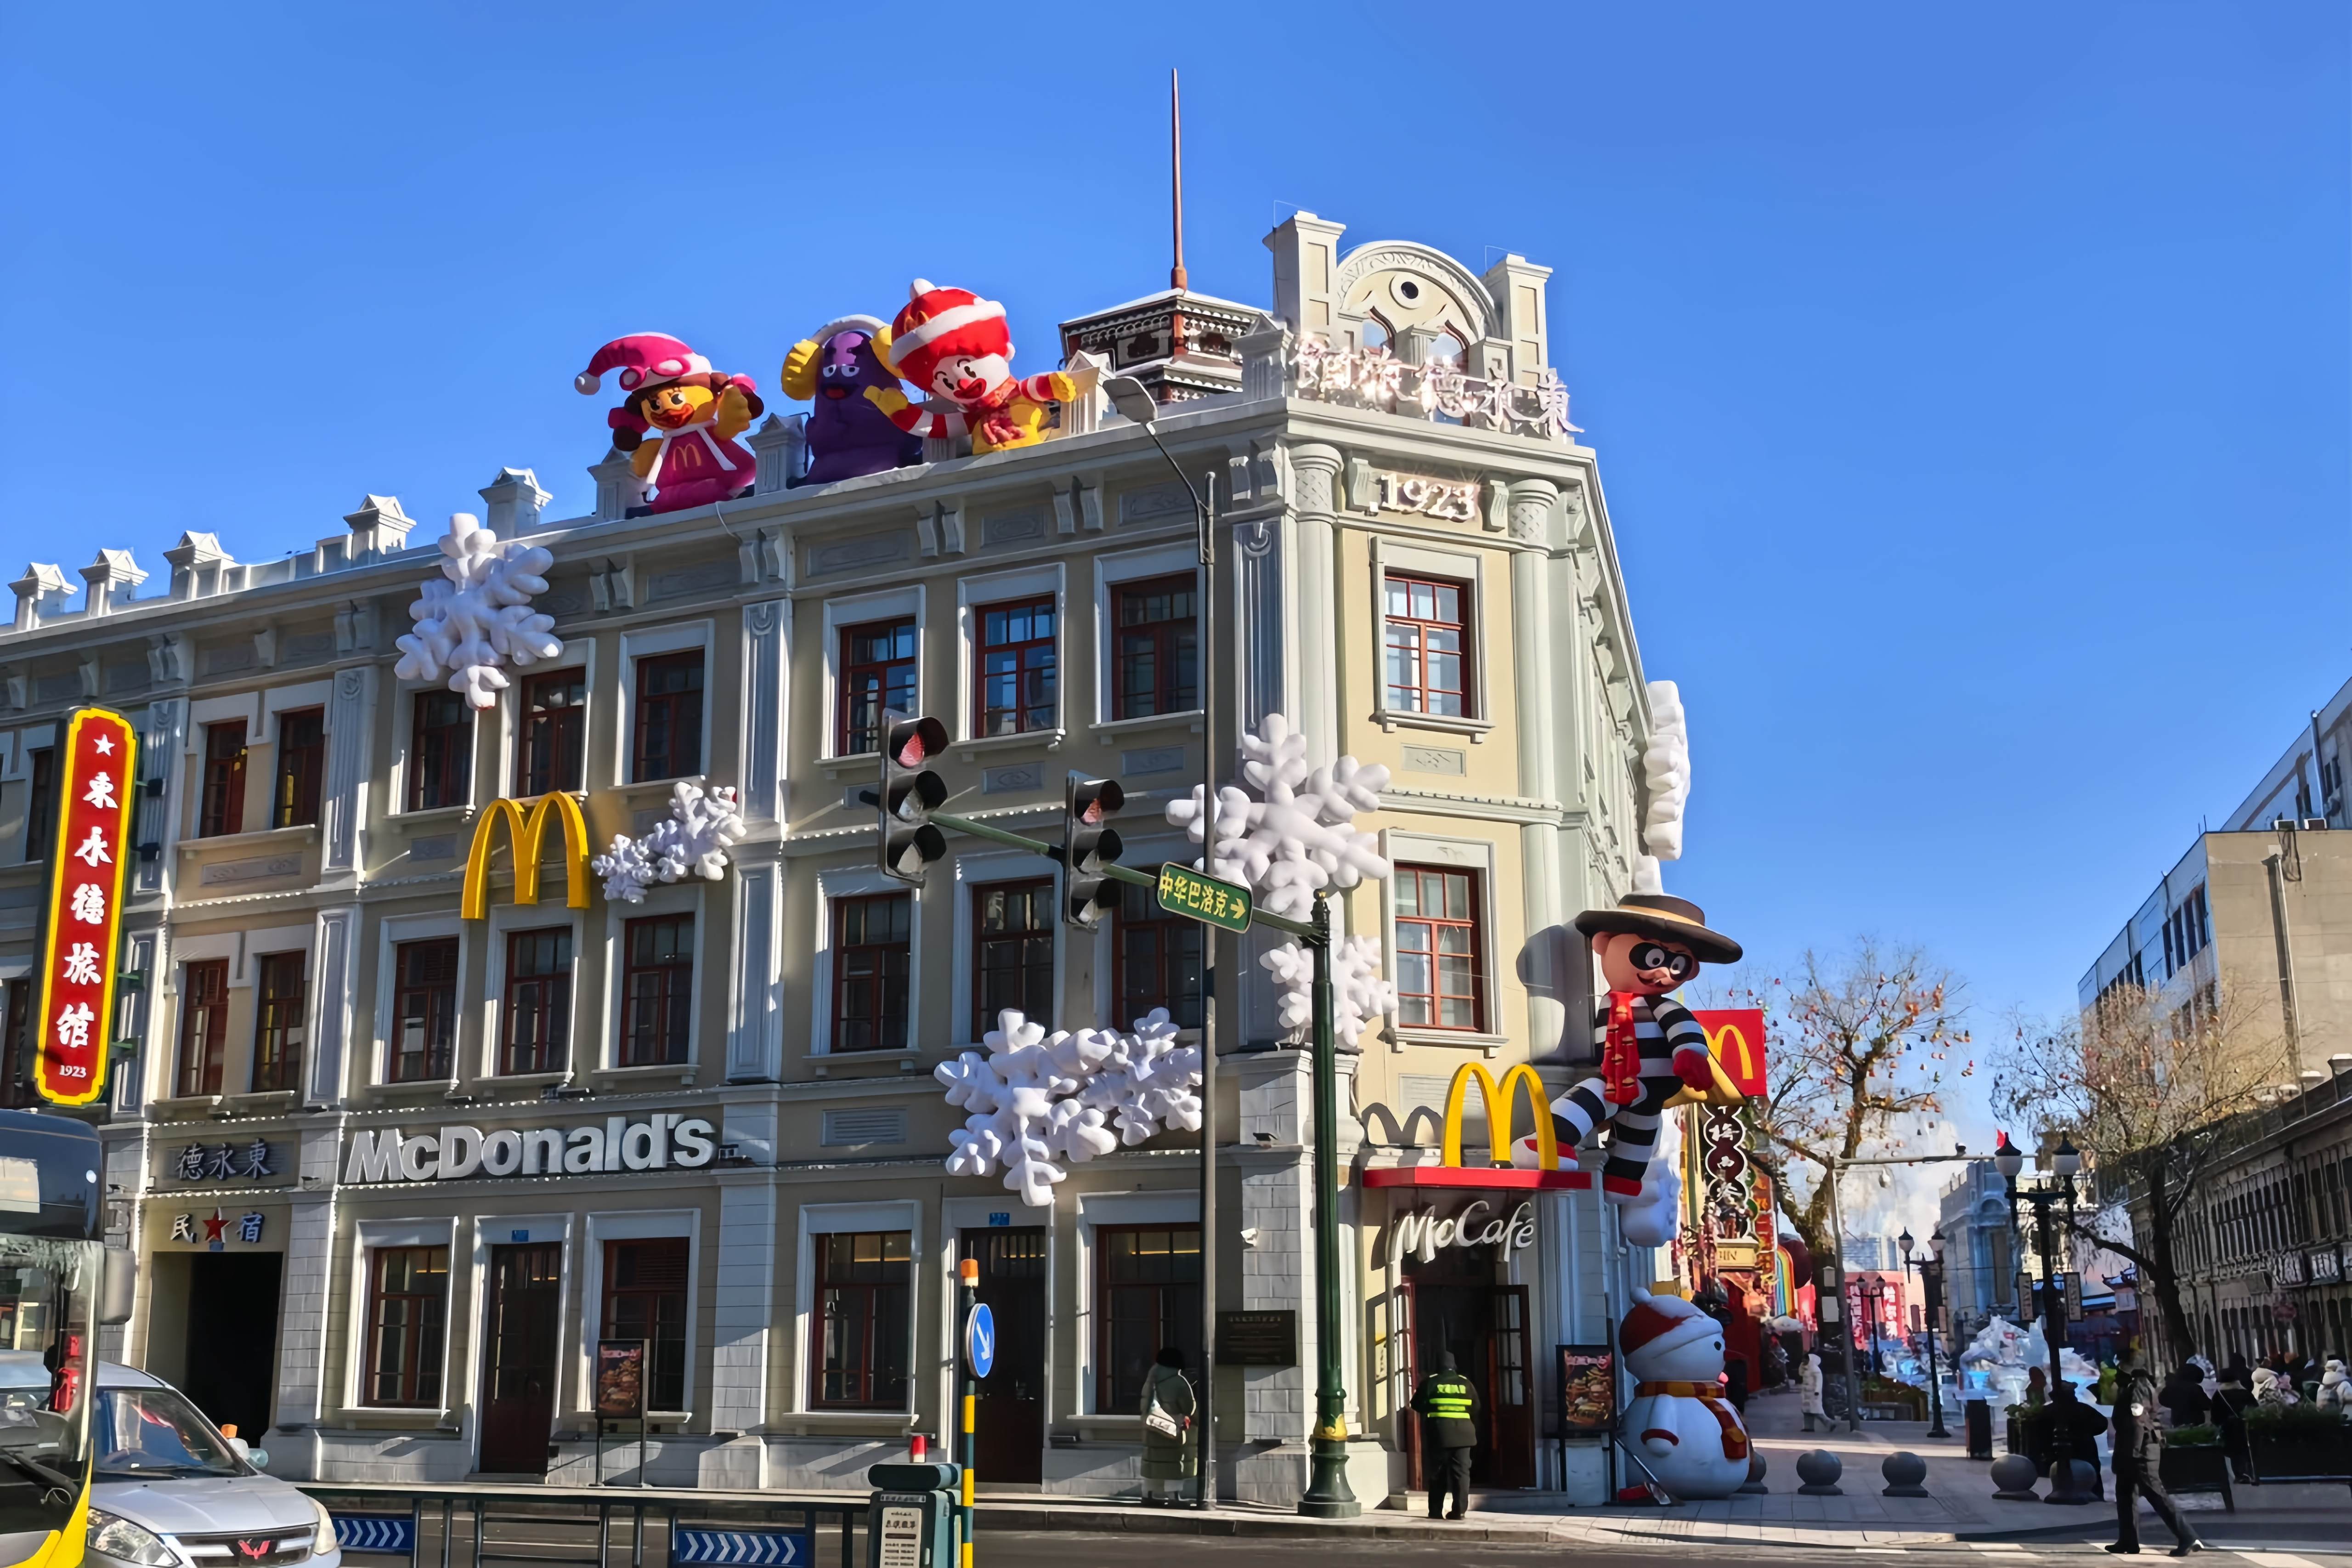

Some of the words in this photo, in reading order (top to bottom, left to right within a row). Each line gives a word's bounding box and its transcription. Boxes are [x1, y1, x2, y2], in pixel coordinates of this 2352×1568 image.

[1380, 473, 1480, 521] 1923
[1159, 871, 1229, 918] 中华巴洛克
[59, 1064, 86, 1078] 1923
[344, 1114, 718, 1184] McDonald's
[1389, 1200, 1534, 1263] McCafé
